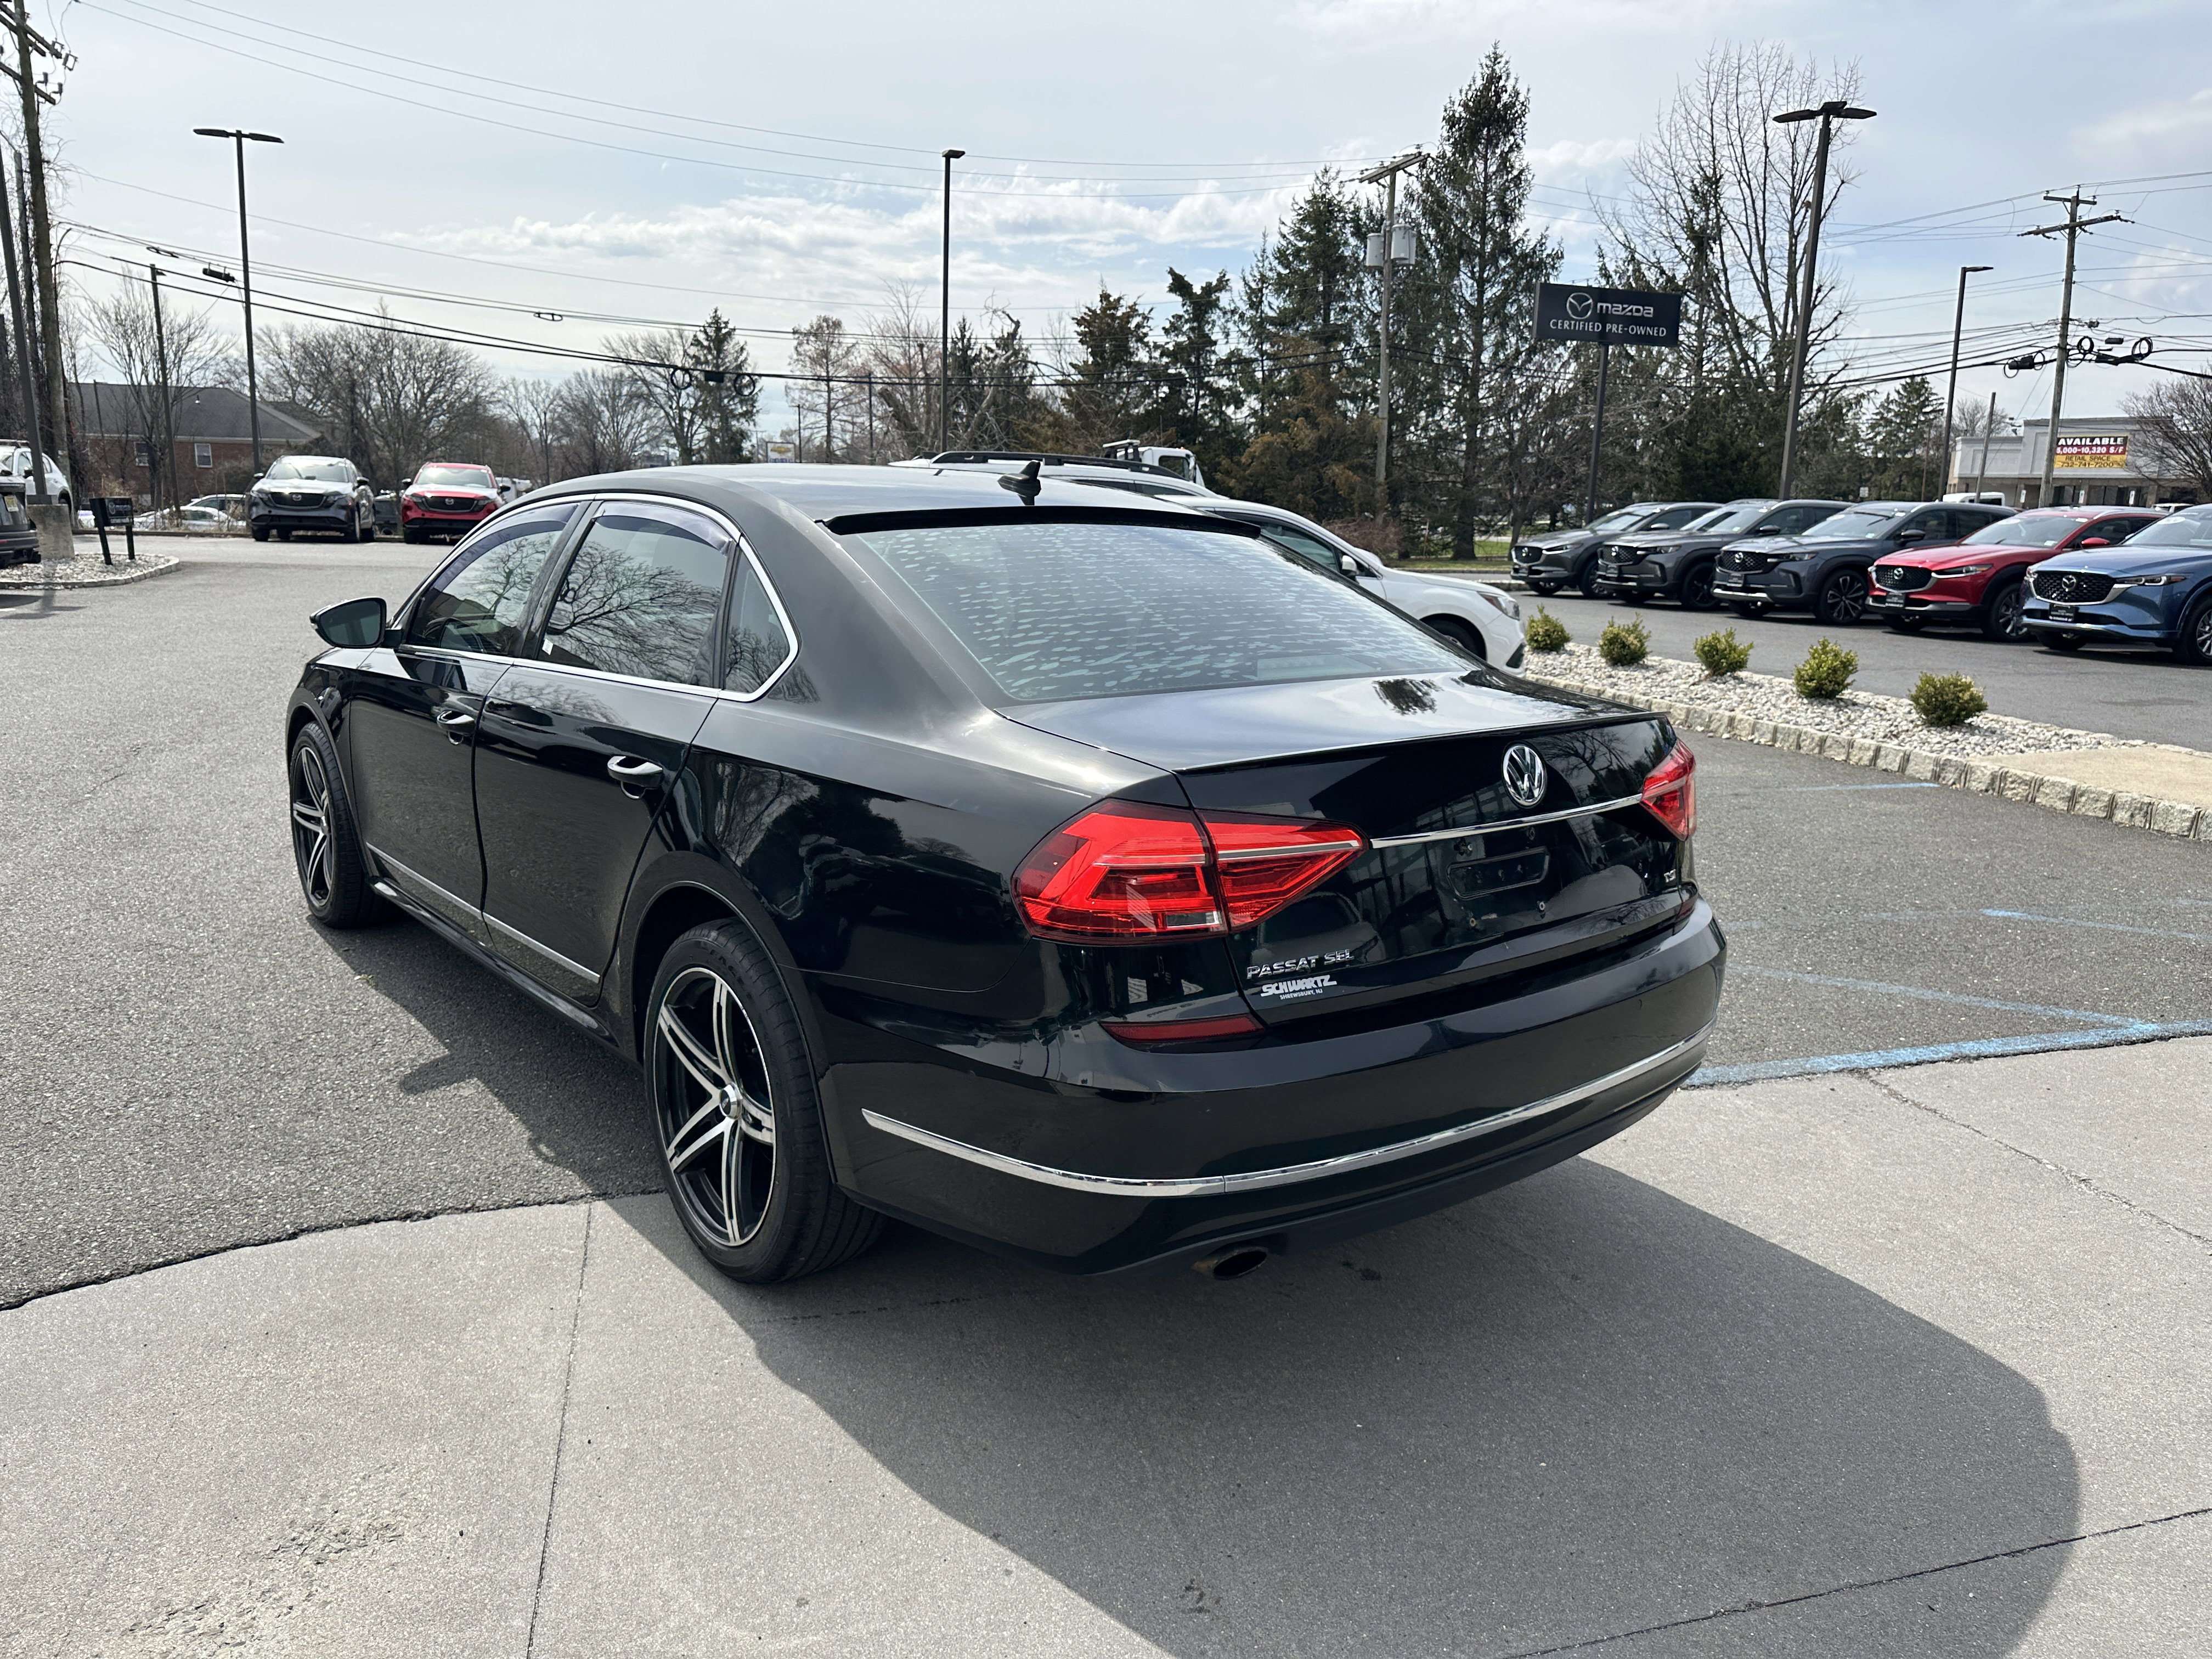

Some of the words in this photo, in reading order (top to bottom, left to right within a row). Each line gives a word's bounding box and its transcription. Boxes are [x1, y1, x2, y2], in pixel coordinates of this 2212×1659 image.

[1596, 302, 1654, 318] mazda
[1550, 319, 1601, 332] CERTIFIED
[1606, 323, 1667, 337] PRE-OWNED
[1246, 955, 1319, 979] PASSAT
[1324, 949, 1355, 965] SEL
[1261, 974, 1338, 997] SCHWARTZ
[1279, 990, 1316, 1000] SHREWSBURY,
